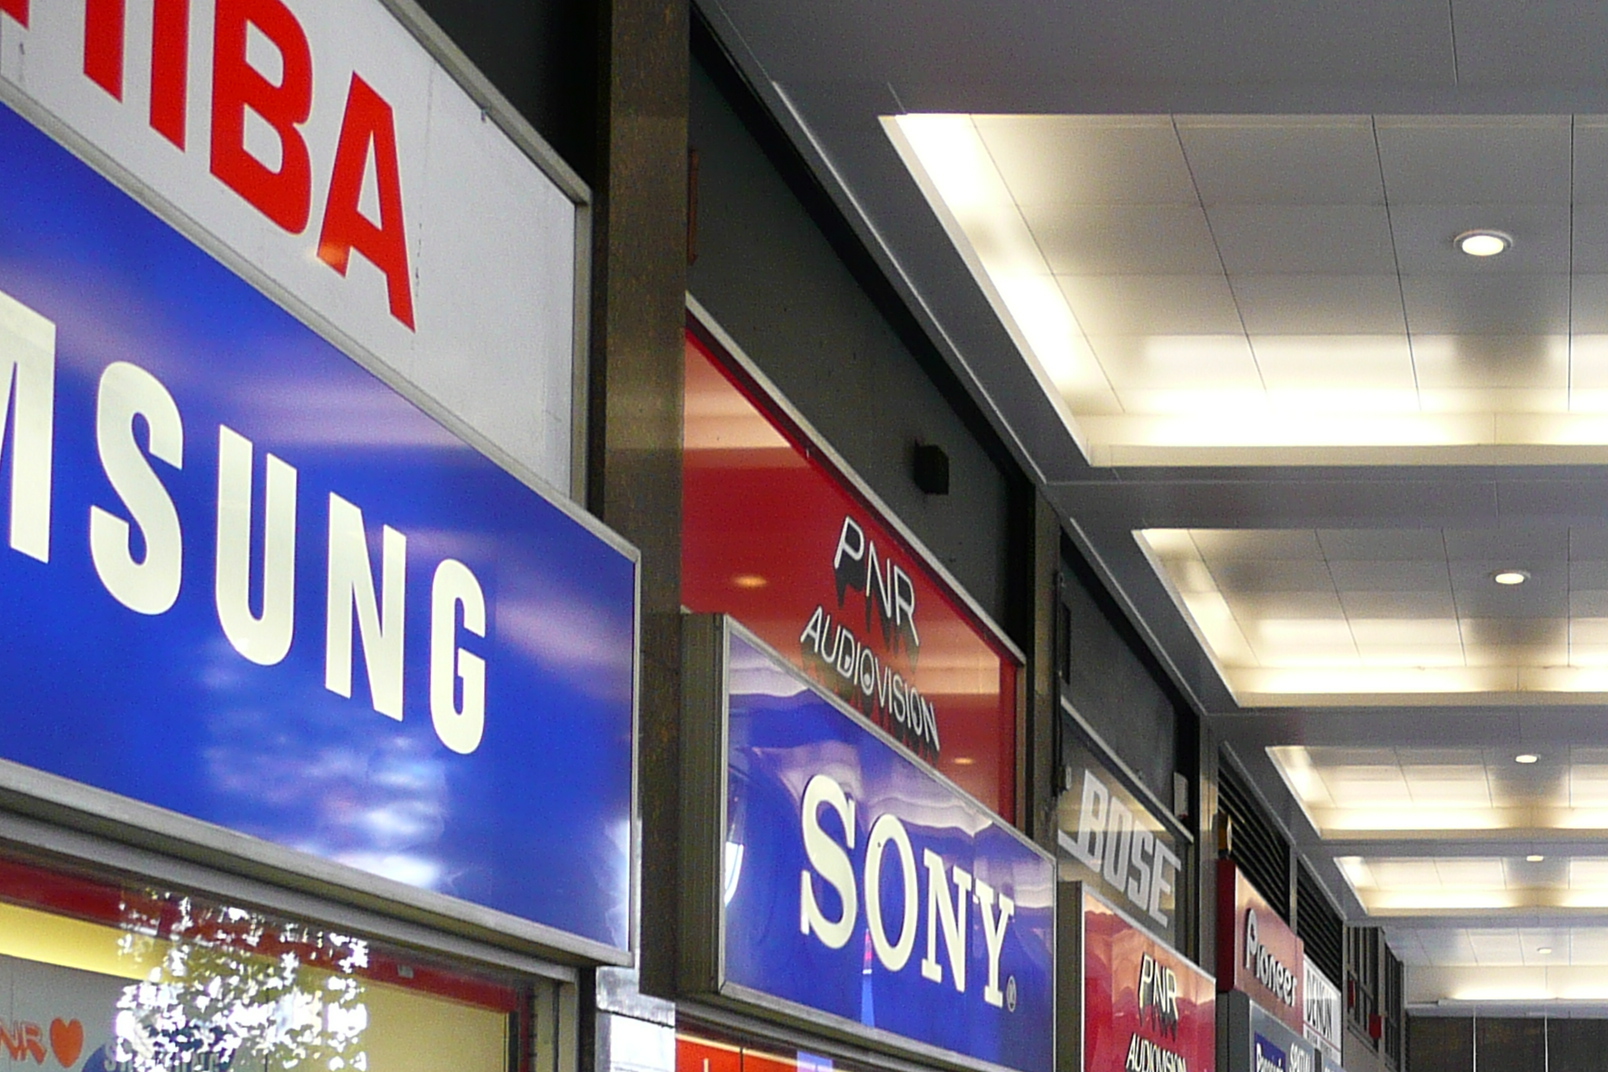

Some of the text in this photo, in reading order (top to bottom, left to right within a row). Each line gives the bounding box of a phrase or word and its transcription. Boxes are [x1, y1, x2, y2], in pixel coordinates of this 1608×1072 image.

[833, 515, 920, 647] PNR
[800, 605, 940, 752] AUDIOVISION
[1057, 769, 1182, 929] BOSE
[1138, 952, 1179, 1020] PNR
[1244, 907, 1298, 1008] Pioneer
